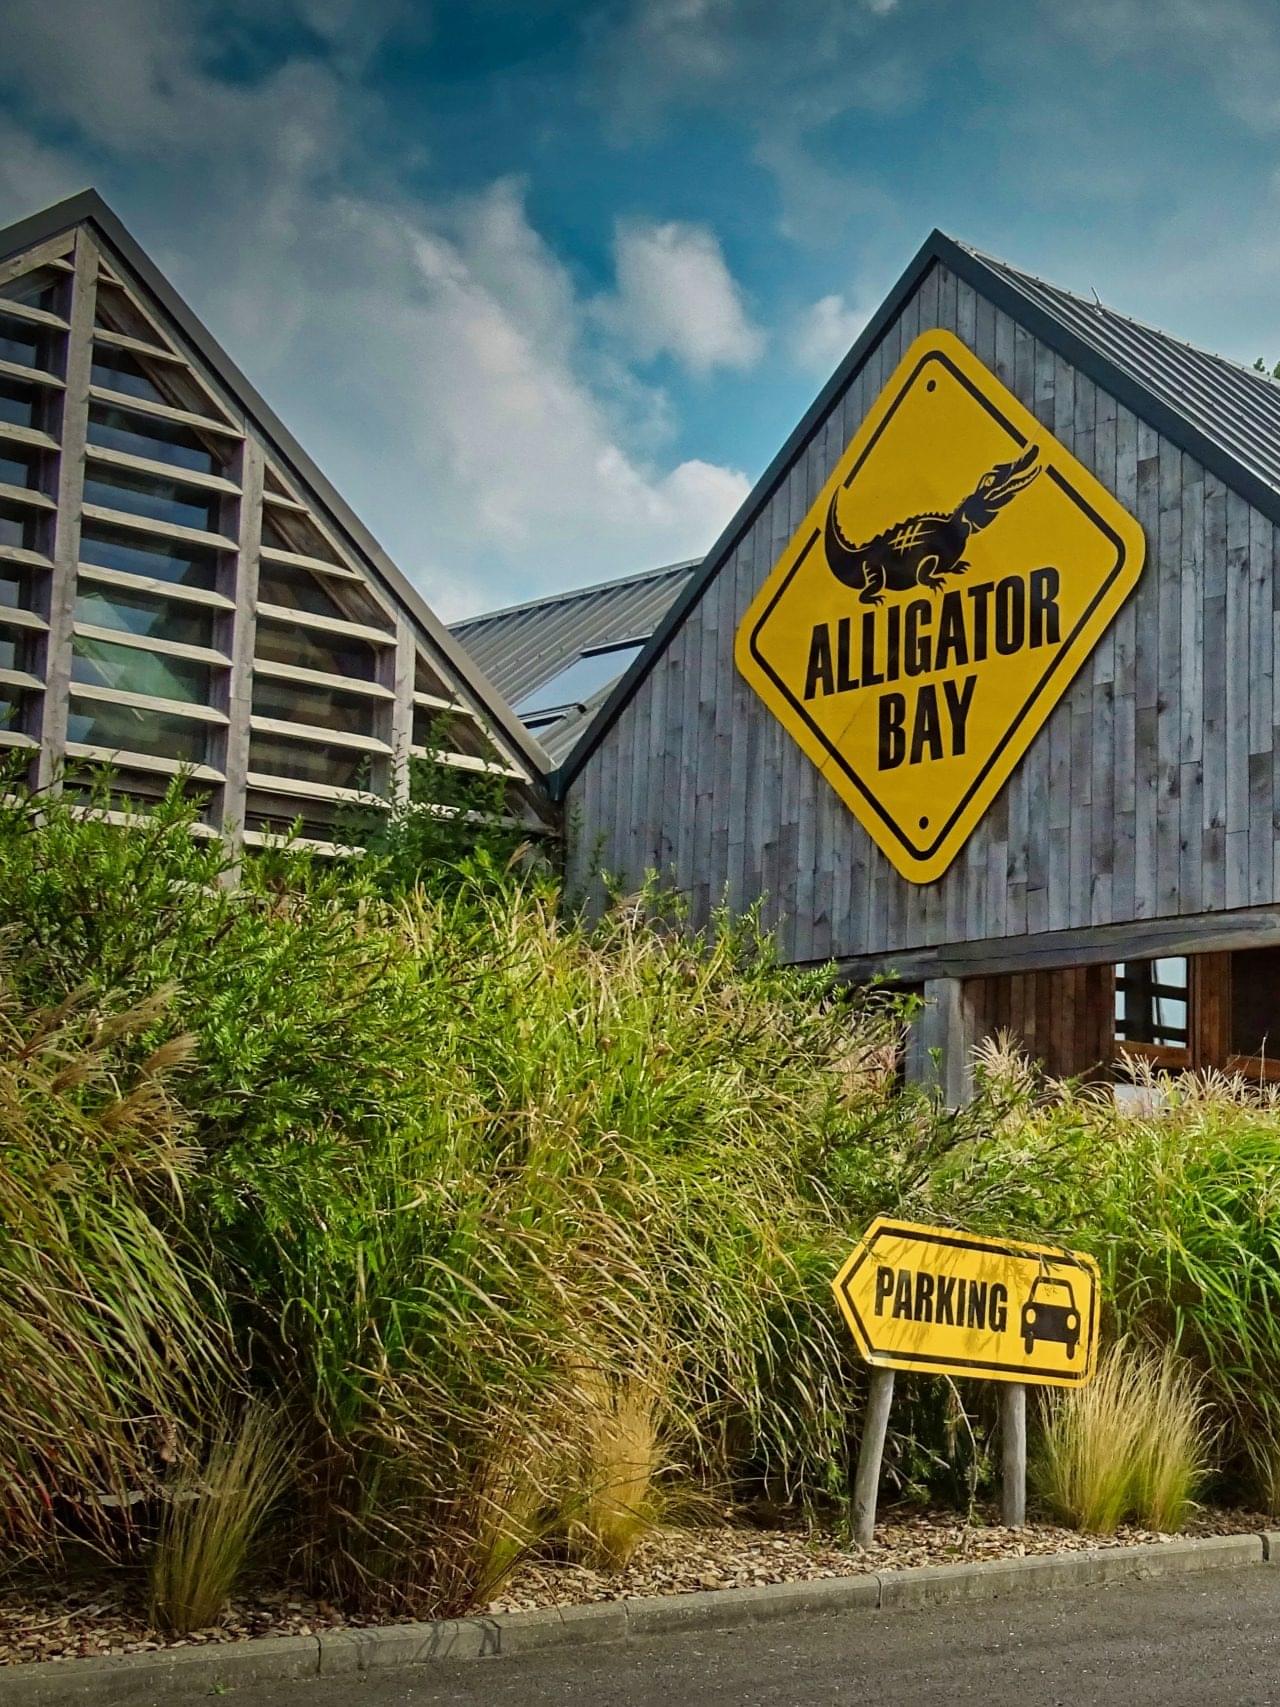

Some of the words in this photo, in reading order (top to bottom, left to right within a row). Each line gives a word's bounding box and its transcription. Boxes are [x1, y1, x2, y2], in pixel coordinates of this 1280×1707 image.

[804, 566, 1061, 700] ALLIGATOR
[878, 674, 978, 772] BAY
[874, 1265, 1008, 1333] PARKING
